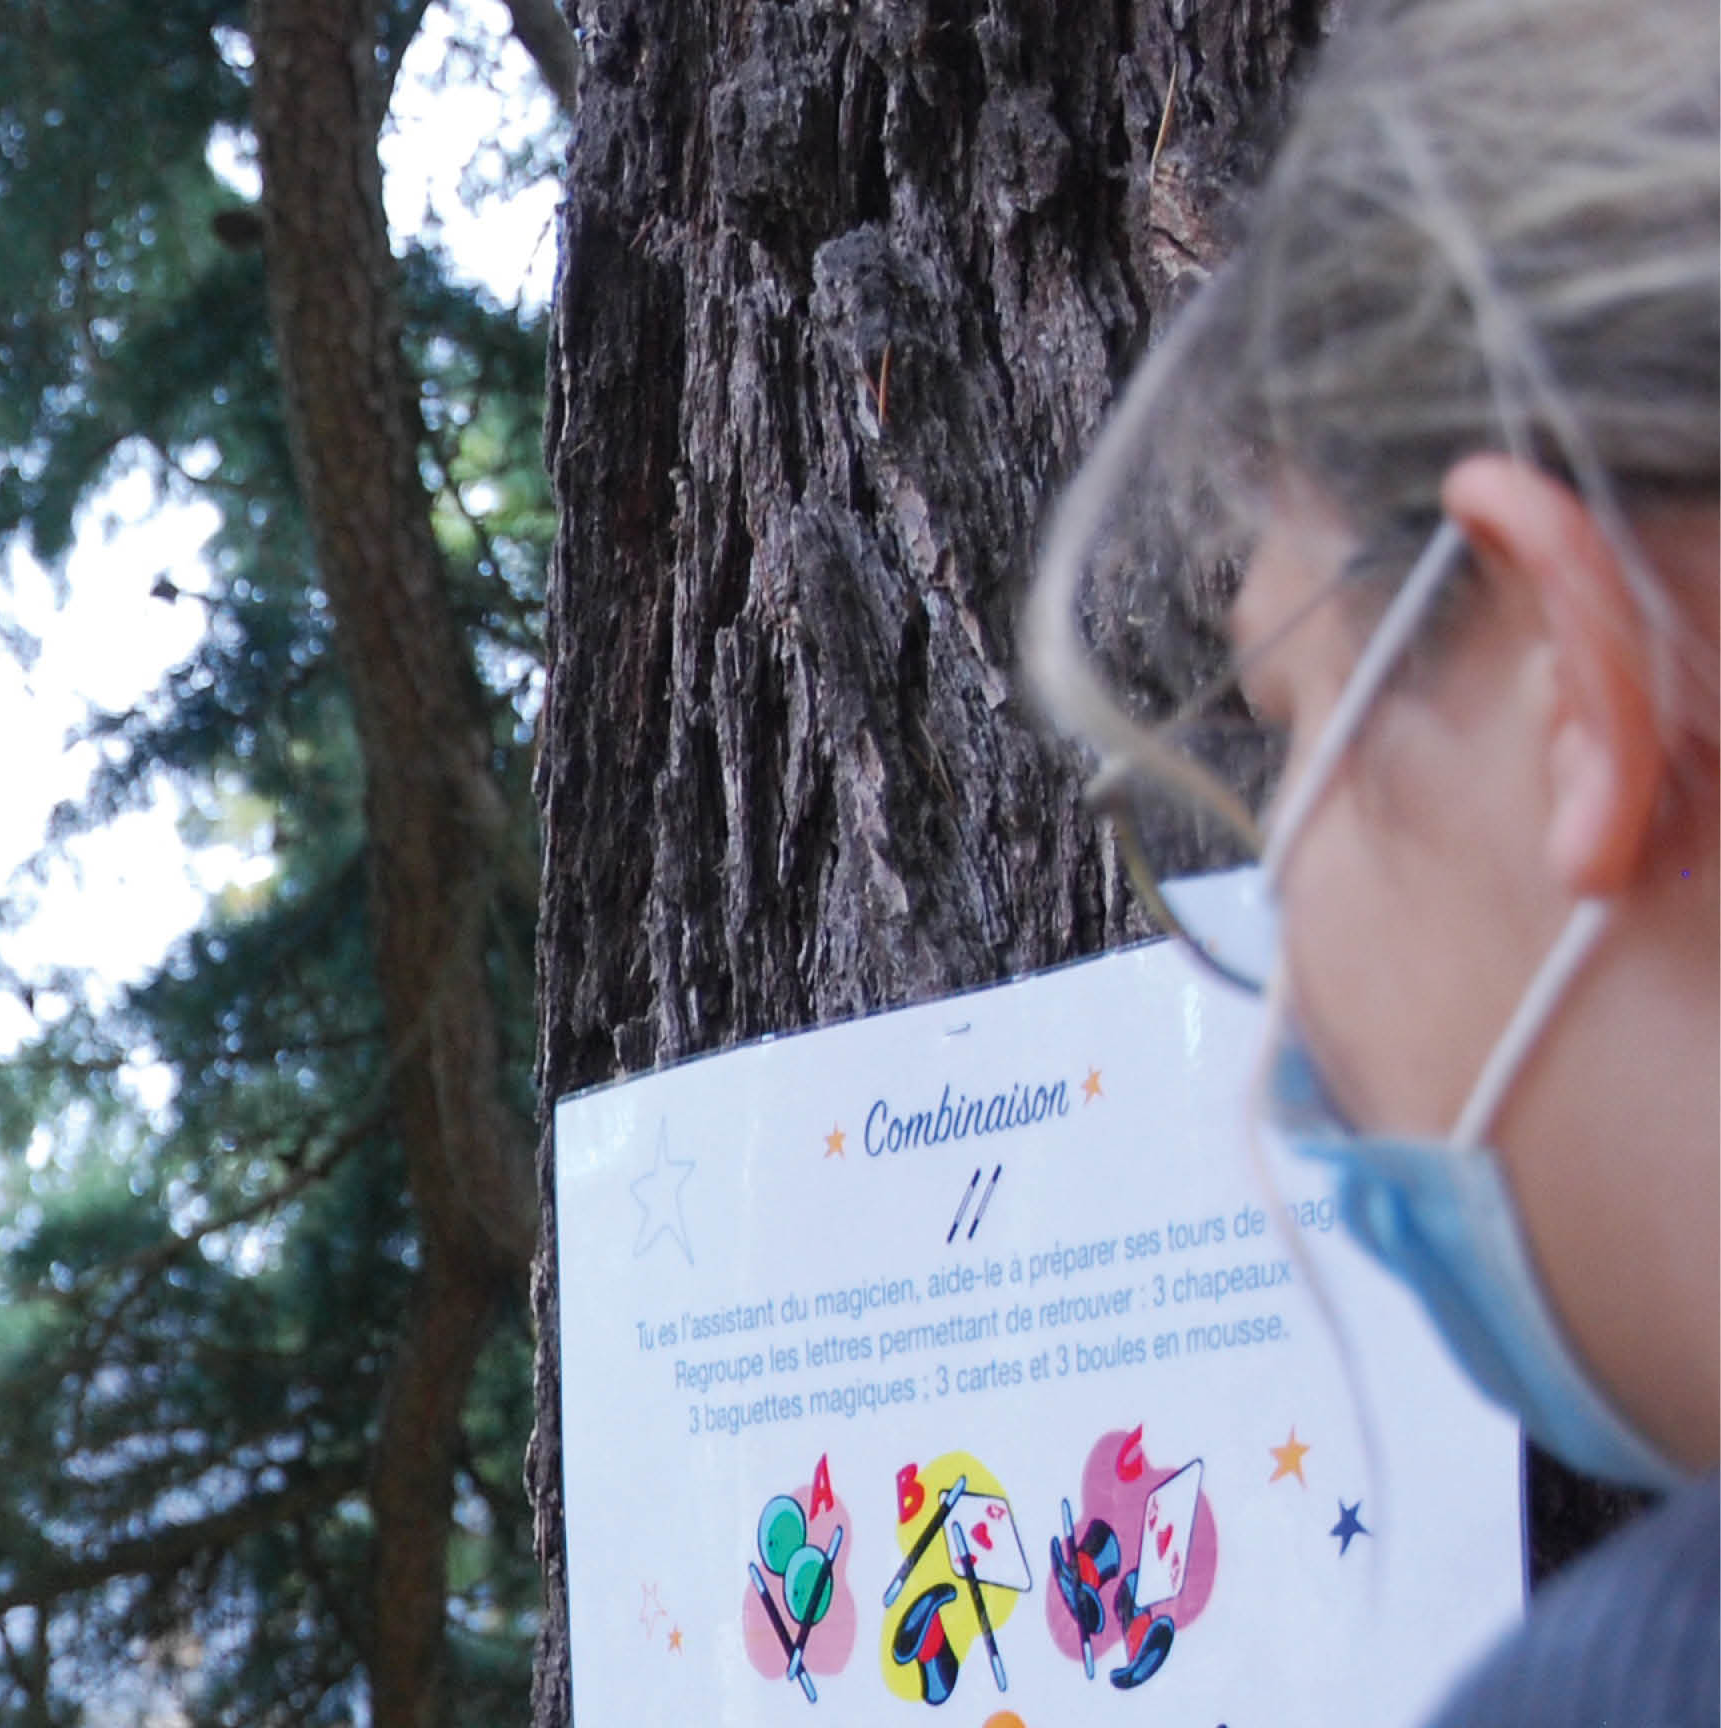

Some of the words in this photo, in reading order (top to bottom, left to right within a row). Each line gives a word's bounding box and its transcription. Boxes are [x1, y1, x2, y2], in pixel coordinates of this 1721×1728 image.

[864, 1080, 1069, 1157] Combinaison
[636, 1321, 654, 1350] Tu
[658, 1321, 677, 1347] es
[681, 1297, 774, 1342] l'assistant
[780, 1292, 807, 1323] du
[815, 1276, 921, 1320] magicien,
[928, 1258, 1003, 1298] aide-le
[1009, 1253, 1022, 1283] à
[1030, 1240, 1117, 1287] préparer
[1124, 1229, 1161, 1260] ses
[1168, 1216, 1225, 1252] tours
[1234, 1204, 1265, 1239] de
[675, 1353, 763, 1393] Regroupe
[770, 1344, 798, 1374] les
[805, 1334, 872, 1369] lettres
[879, 1308, 998, 1362] permettant
[1006, 1304, 1033, 1335] de
[1039, 1287, 1133, 1328] retrouver
[1152, 1273, 1166, 1307] 3
[1173, 1260, 1292, 1304] chapeaux
[689, 1405, 699, 1435] 3
[705, 1393, 803, 1436] baguettes
[809, 1377, 916, 1419] magiques
[936, 1364, 949, 1397] 3
[957, 1358, 1023, 1393] cartes
[1030, 1350, 1050, 1381] et
[1056, 1343, 1070, 1377] 3
[1076, 1335, 1147, 1373] boules
[1153, 1330, 1179, 1360] en
[1186, 1313, 1291, 1353] mousse.
[809, 1453, 834, 1520] A
[1116, 1424, 1144, 1482] C
[896, 1463, 925, 1526] B
